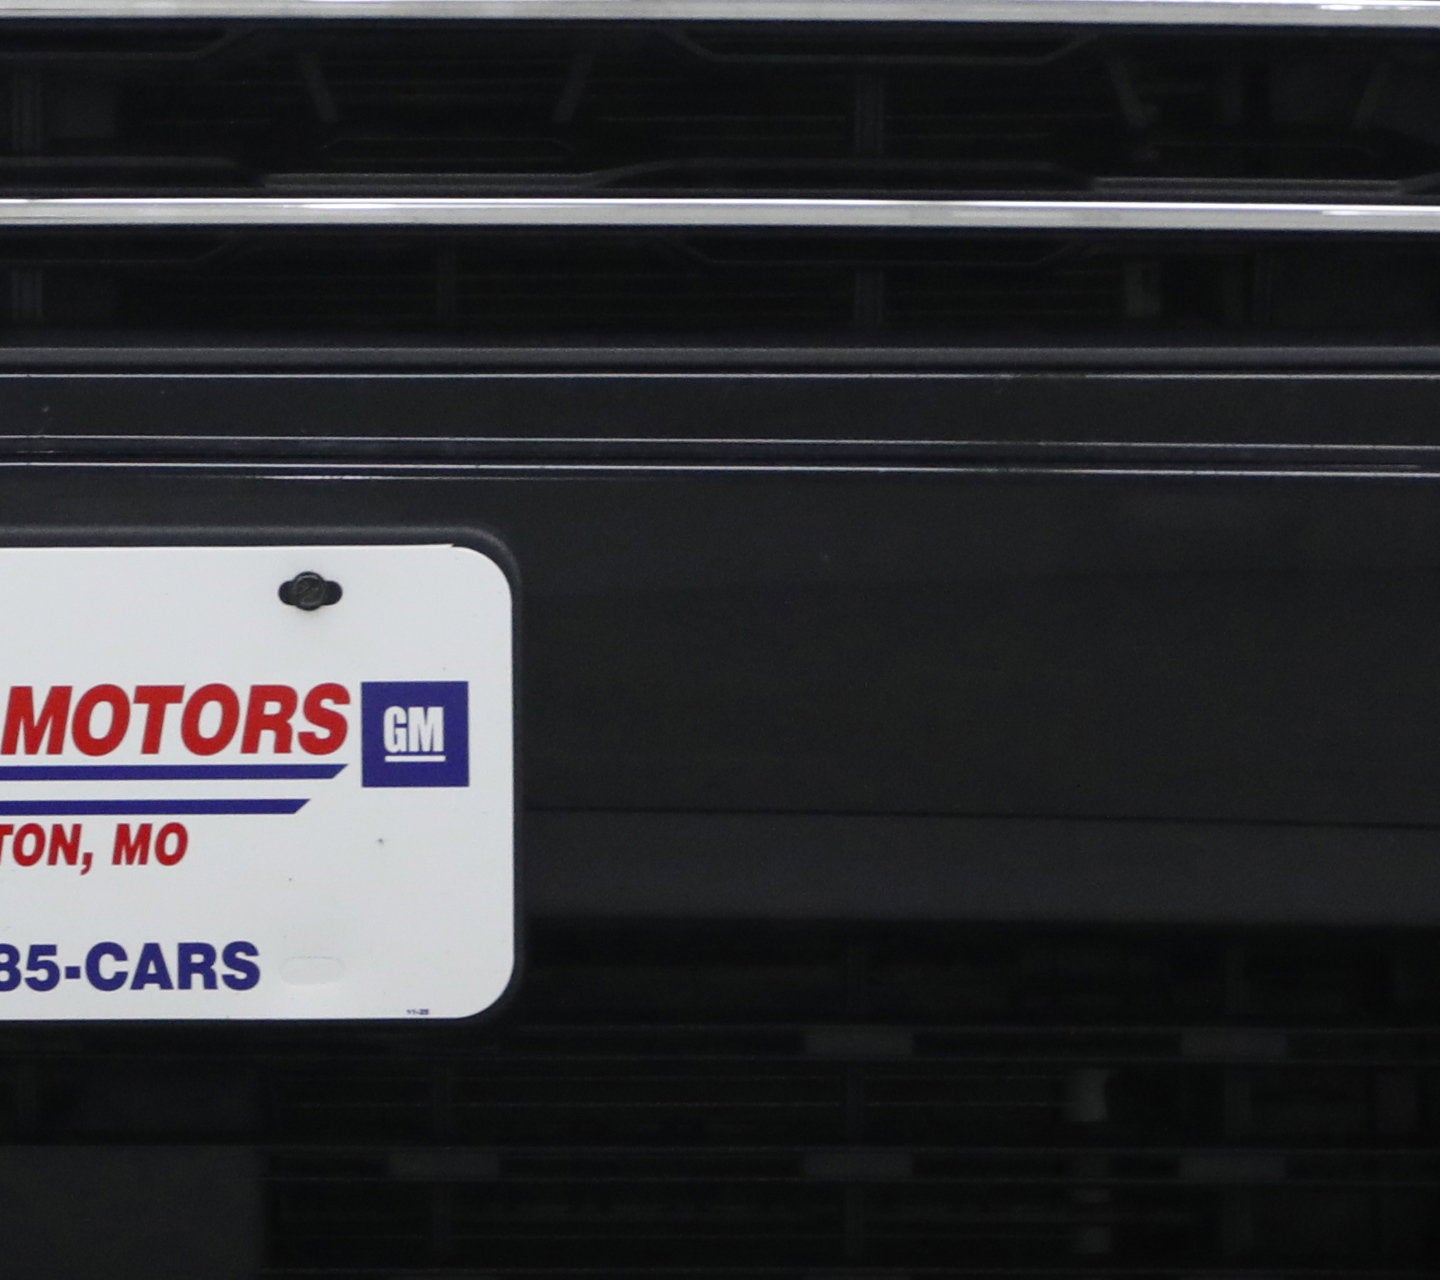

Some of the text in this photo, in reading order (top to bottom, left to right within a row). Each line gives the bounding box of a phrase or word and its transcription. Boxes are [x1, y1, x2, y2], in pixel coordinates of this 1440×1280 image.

[1, 682, 351, 757] MOTORS
[383, 705, 444, 753] GM
[112, 822, 189, 867] MO
